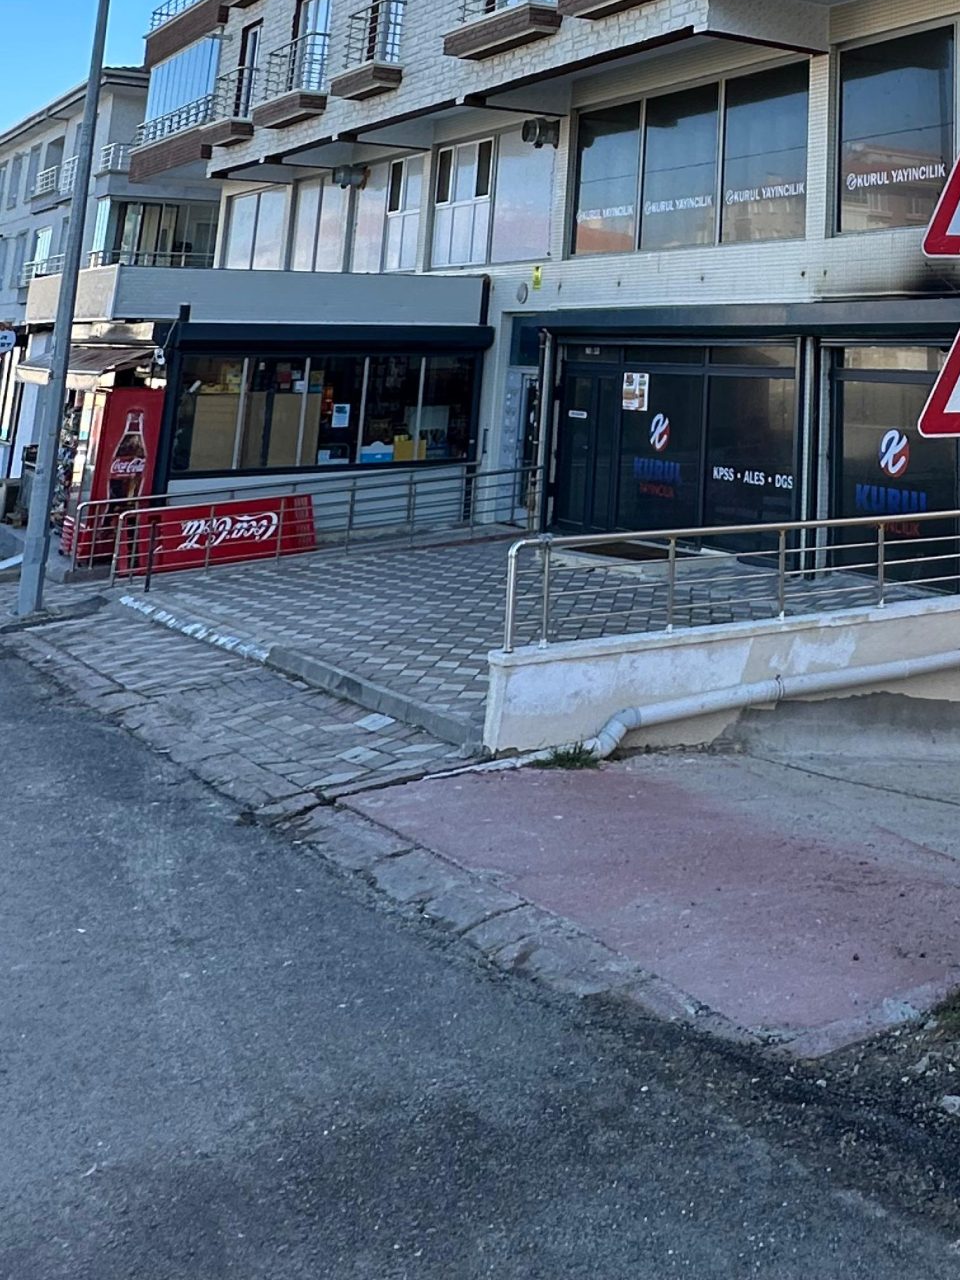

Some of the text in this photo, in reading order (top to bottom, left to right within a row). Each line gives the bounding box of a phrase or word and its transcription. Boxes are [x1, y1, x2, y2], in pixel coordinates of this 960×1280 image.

[856, 163, 946, 188] KURUL YAYINCILIK
[733, 182, 805, 203] KURUL YAYINCILIK
[713, 466, 793, 489] KPSS ALES DGS
[175, 511, 279, 552] Coca-Cola
